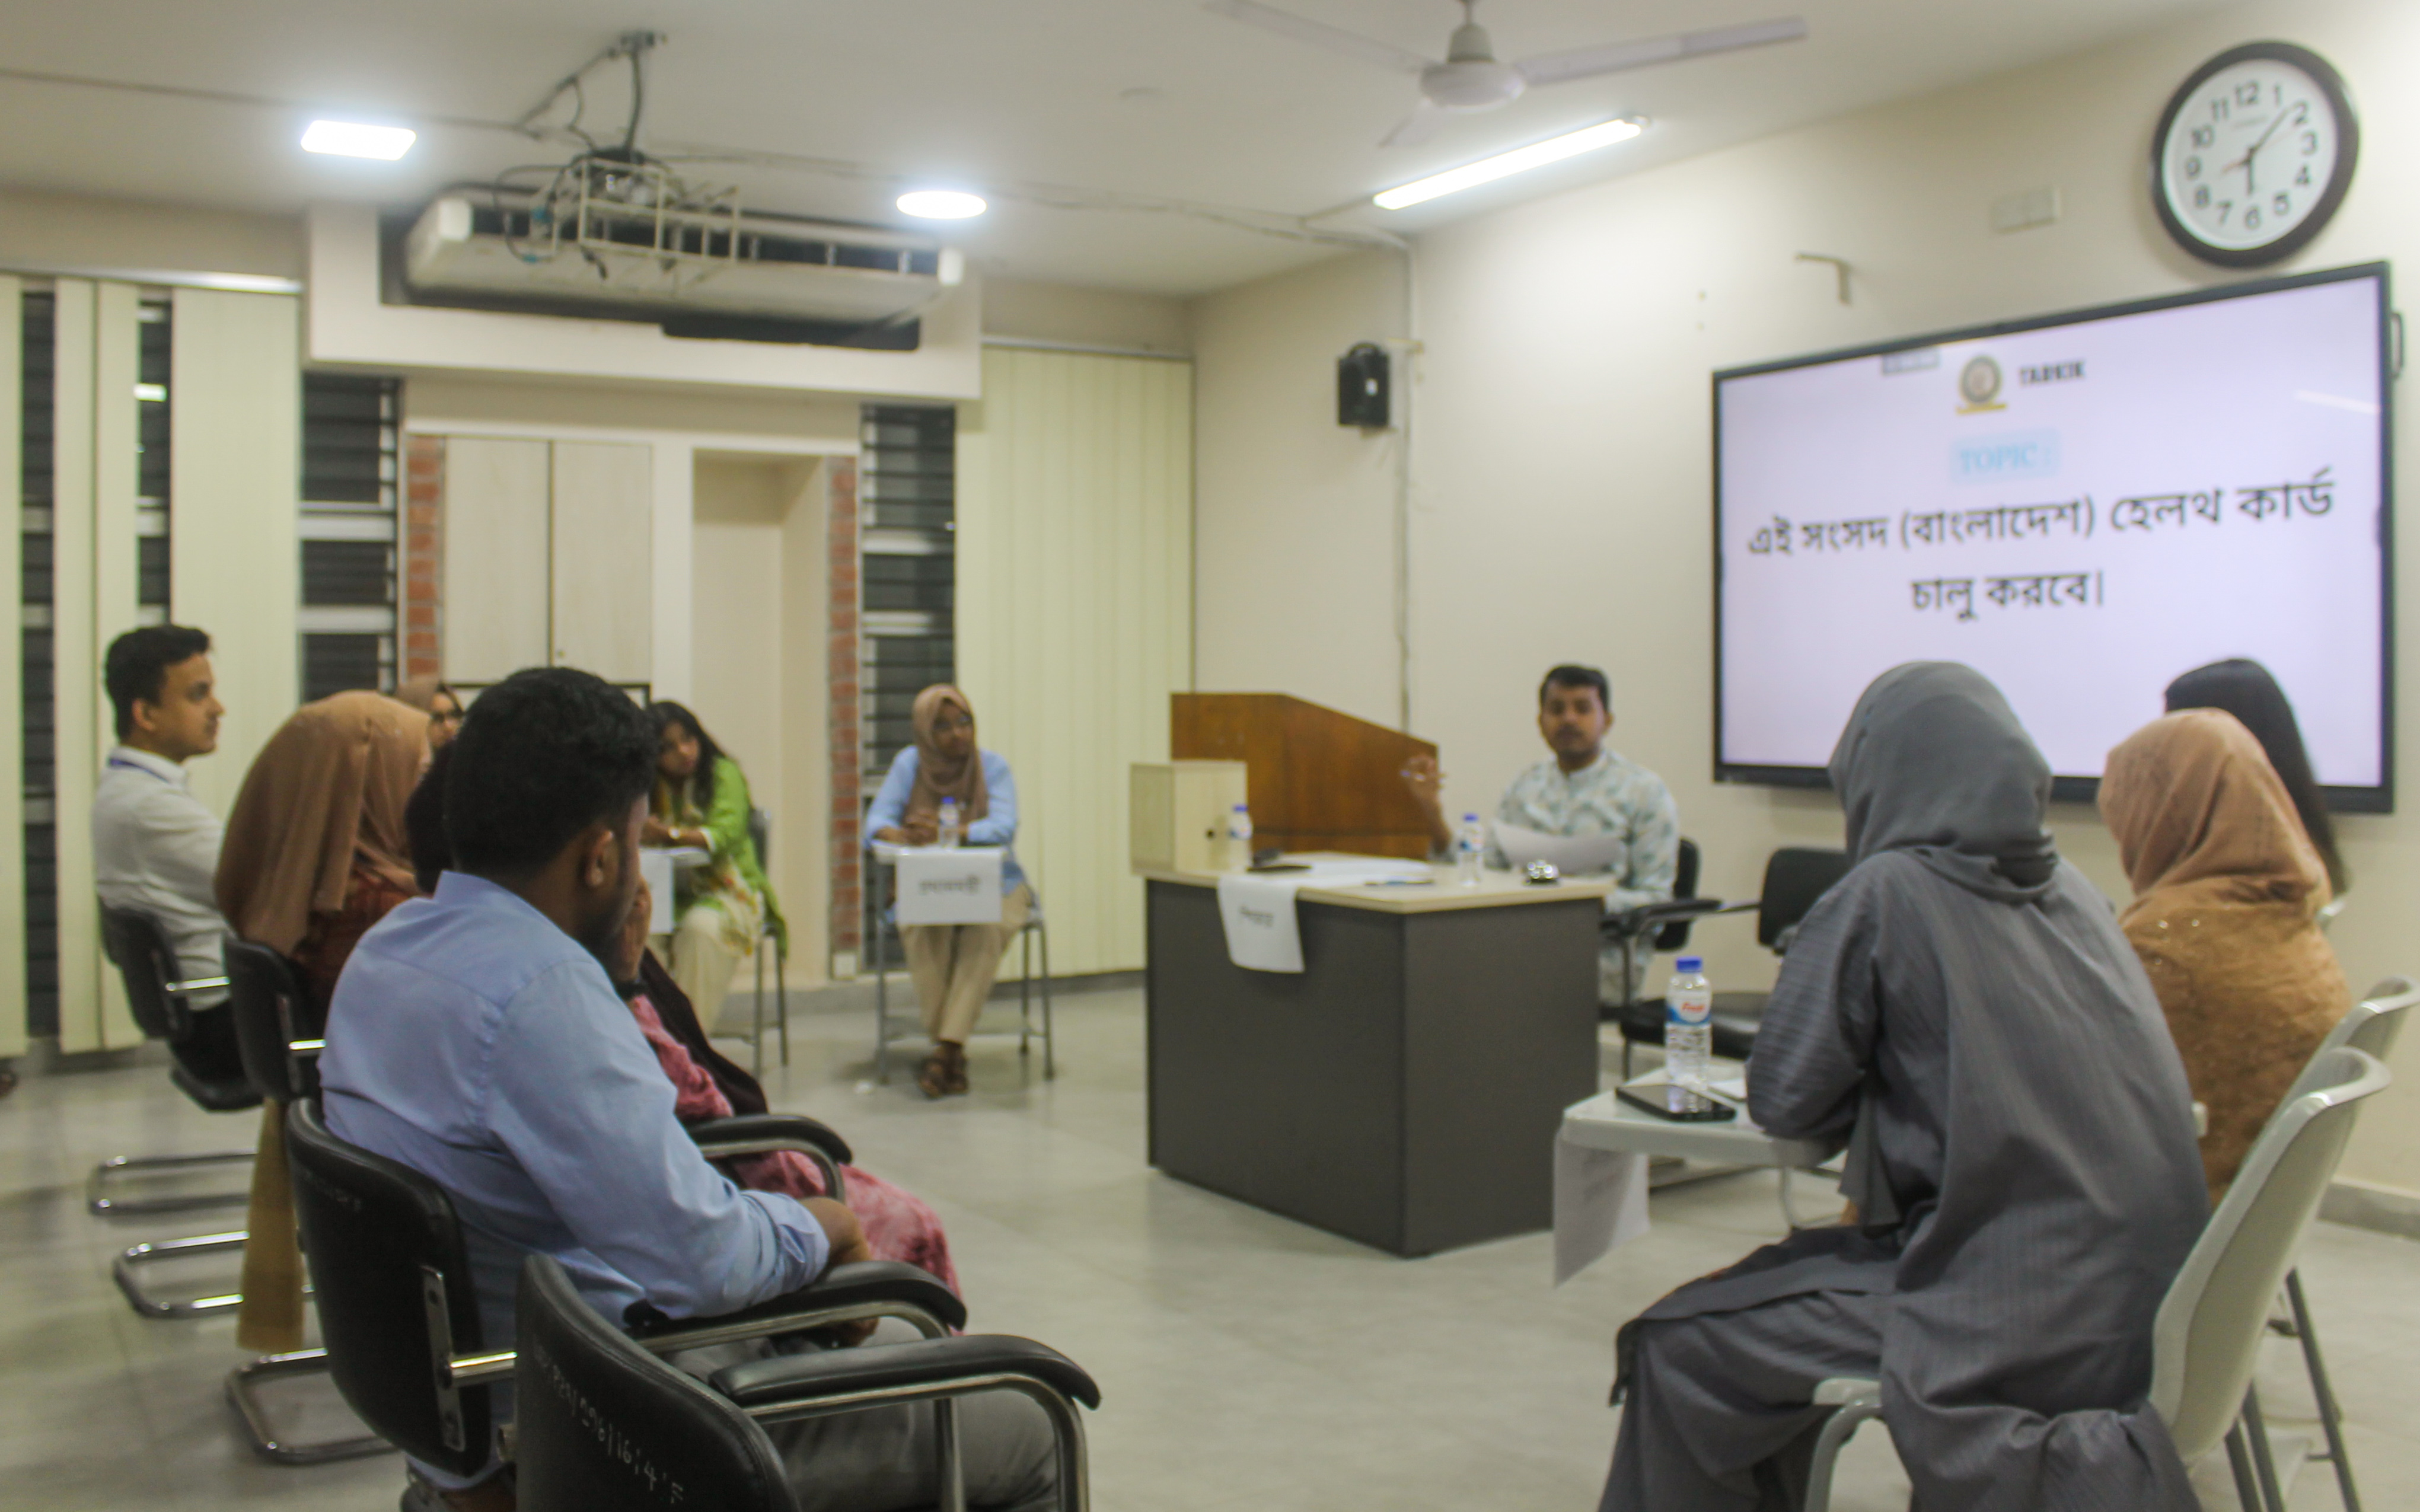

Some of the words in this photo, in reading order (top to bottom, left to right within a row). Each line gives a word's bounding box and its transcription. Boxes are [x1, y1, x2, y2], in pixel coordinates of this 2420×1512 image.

[2235, 81, 2259, 106] 12
[2211, 97, 2229, 122] 11
[2292, 101, 2309, 127] 2
[2192, 125, 2215, 148] 10
[2301, 132, 2317, 155] 3
[2185, 155, 2201, 180] 9
[2295, 164, 2310, 186] 4
[2195, 184, 2211, 209] 8
[2274, 191, 2291, 216] 5
[2217, 200, 2233, 225] 7
[2244, 206, 2261, 230] 6
[1959, 443, 2039, 473] TOPIC
[1748, 515, 1793, 556] এই
[1801, 516, 1889, 552] সংসদ
[1900, 494, 2096, 550] (বাংলাদেশ)
[2110, 486, 2224, 532] হেলথ
[2235, 465, 2336, 521] কার্ড
[1910, 576, 1979, 623] চালু
